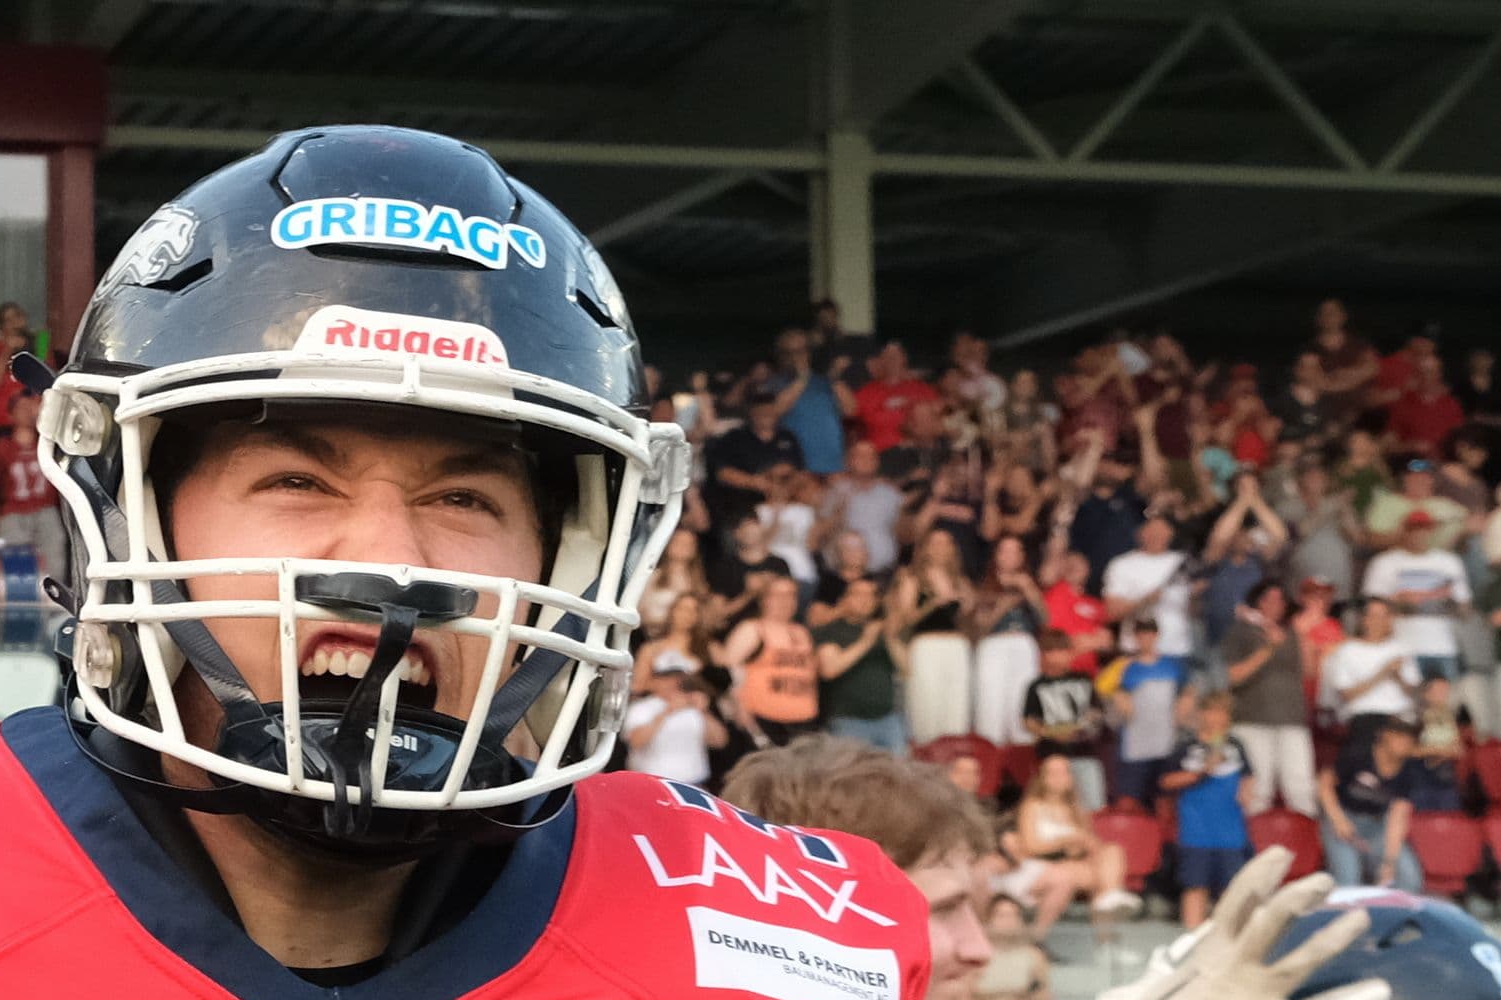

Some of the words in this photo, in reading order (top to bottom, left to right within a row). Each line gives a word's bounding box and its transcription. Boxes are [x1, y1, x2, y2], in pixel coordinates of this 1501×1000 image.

[279, 203, 500, 262] GRIBAG
[632, 832, 899, 926] LAAX
[708, 929, 794, 961] DEMMEL
[798, 950, 811, 966] &
[813, 956, 889, 989] PARTNER
